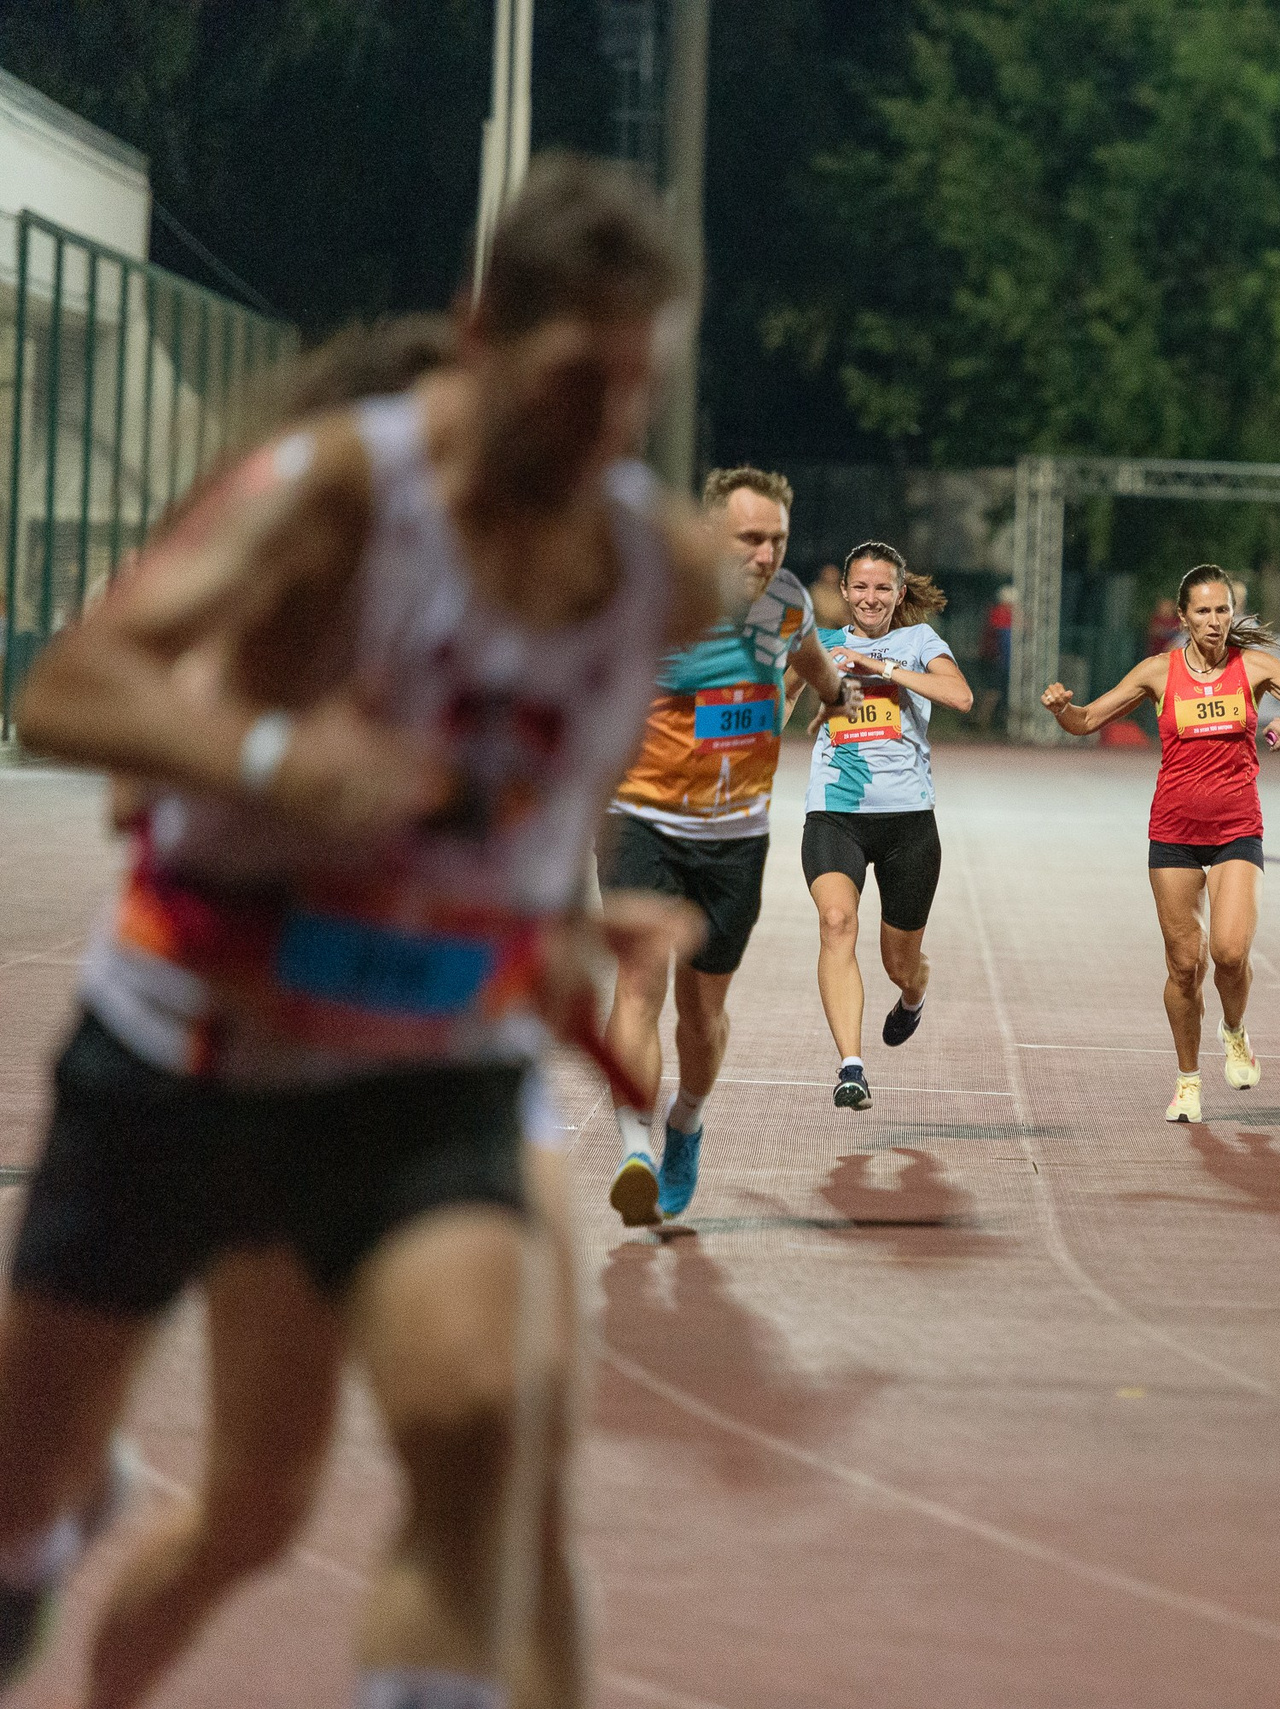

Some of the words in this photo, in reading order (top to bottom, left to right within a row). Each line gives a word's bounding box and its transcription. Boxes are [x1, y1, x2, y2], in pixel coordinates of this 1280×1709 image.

[720, 708, 753, 732] 316
[885, 711, 892, 721] 2
[1196, 700, 1226, 720] 315
[1233, 707, 1240, 716] 2
